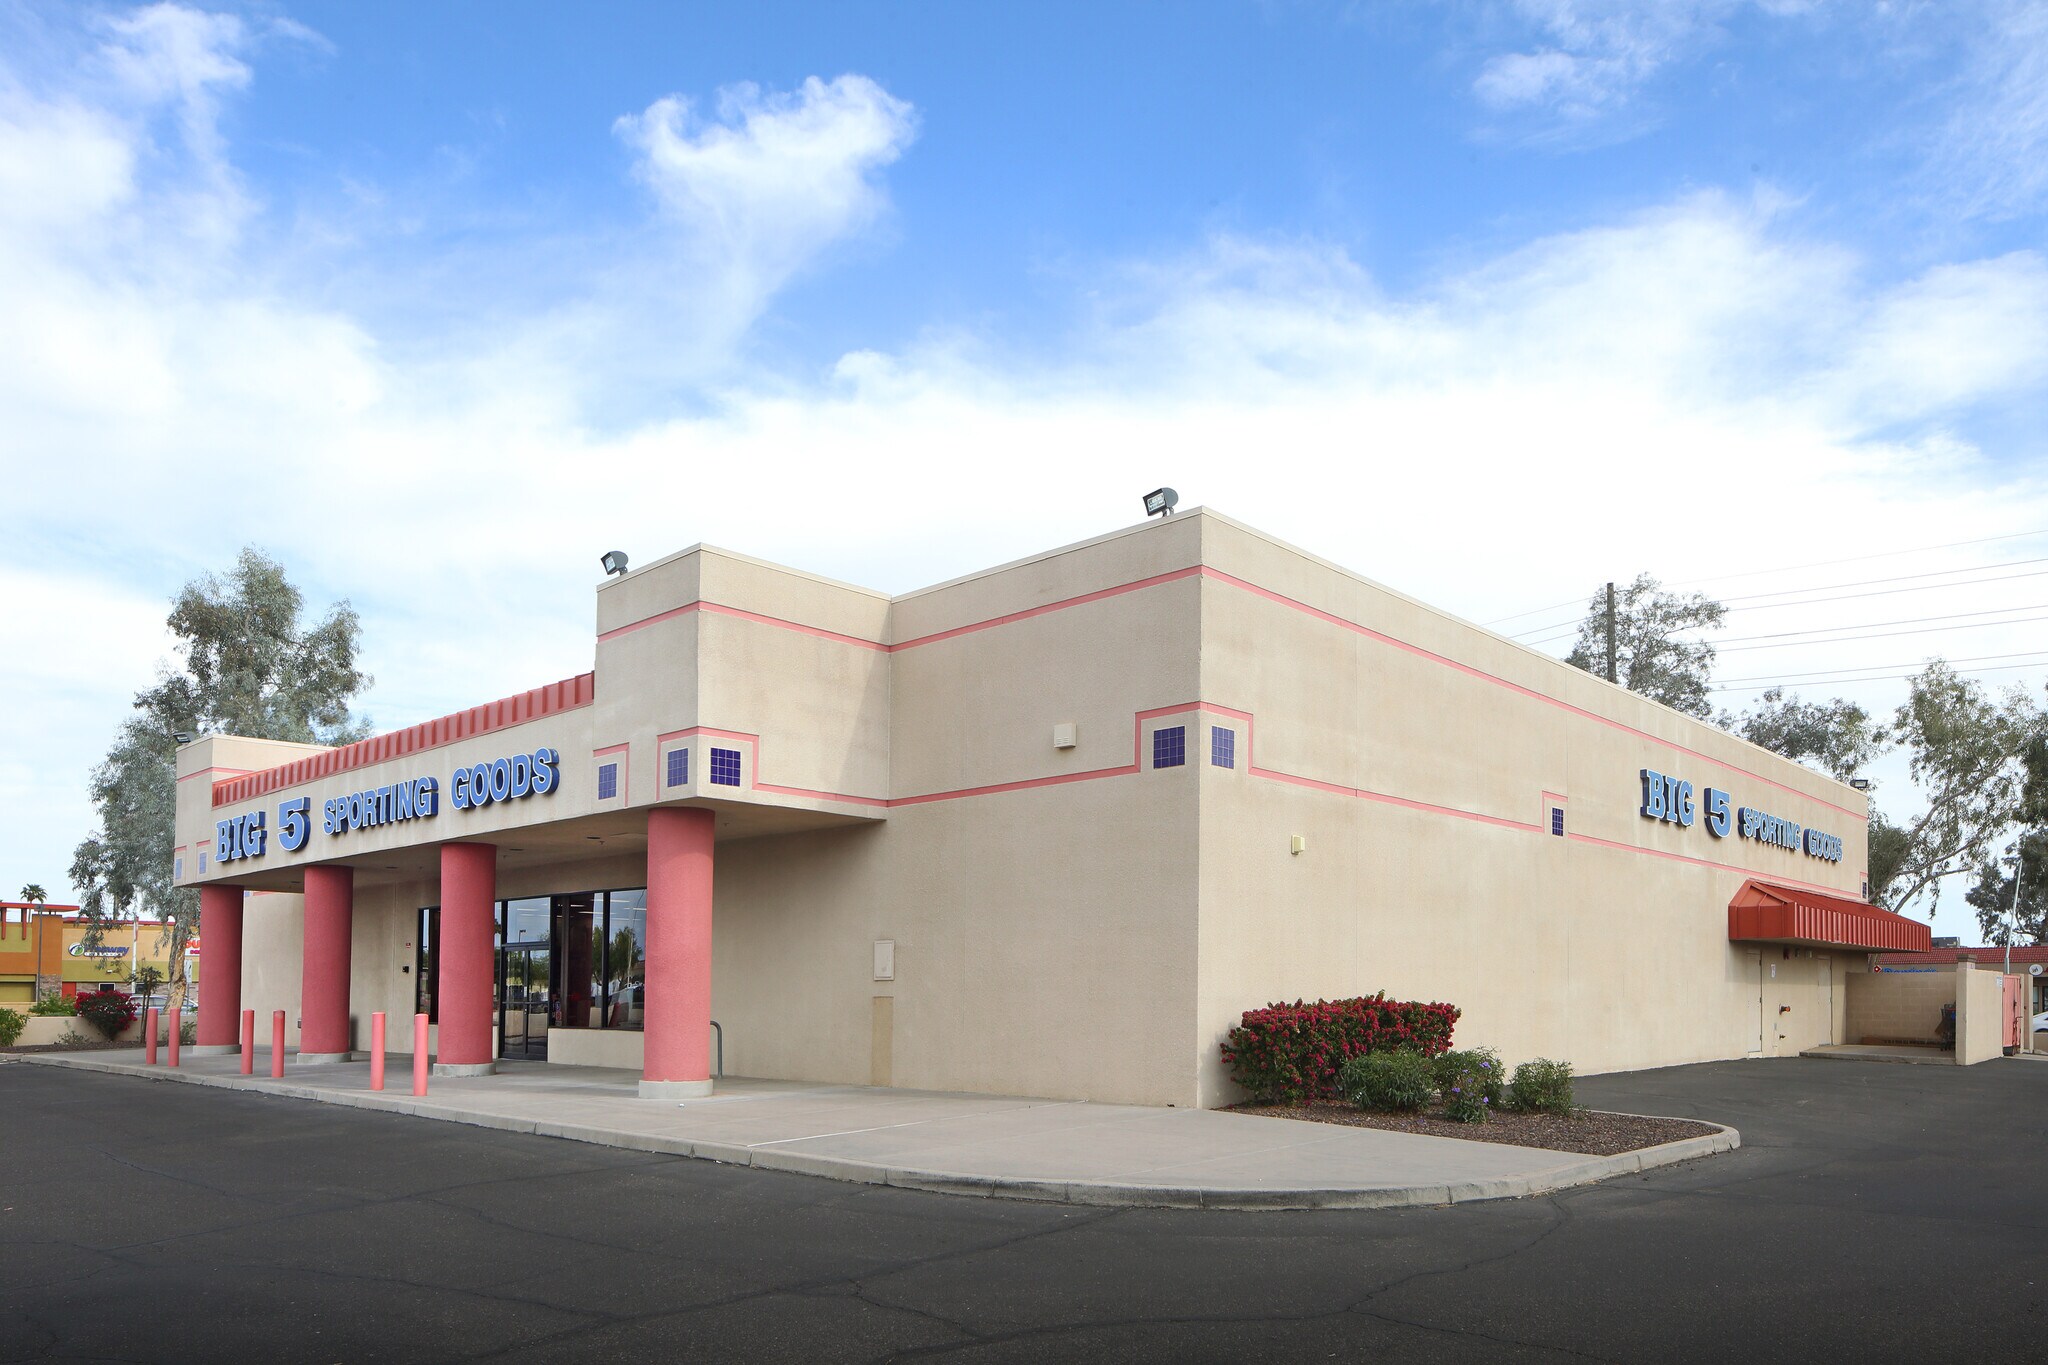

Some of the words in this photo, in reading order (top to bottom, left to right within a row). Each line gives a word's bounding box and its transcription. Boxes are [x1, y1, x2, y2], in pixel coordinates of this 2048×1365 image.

[215, 811, 267, 863] BIG
[277, 796, 310, 851] 5
[323, 775, 438, 835] SPORTING
[449, 746, 559, 810] GOODS
[1641, 769, 1695, 827] BIG
[1705, 787, 1732, 838] 5
[1739, 807, 1800, 851] SPORTING
[1804, 828, 1843, 864] GOODS
